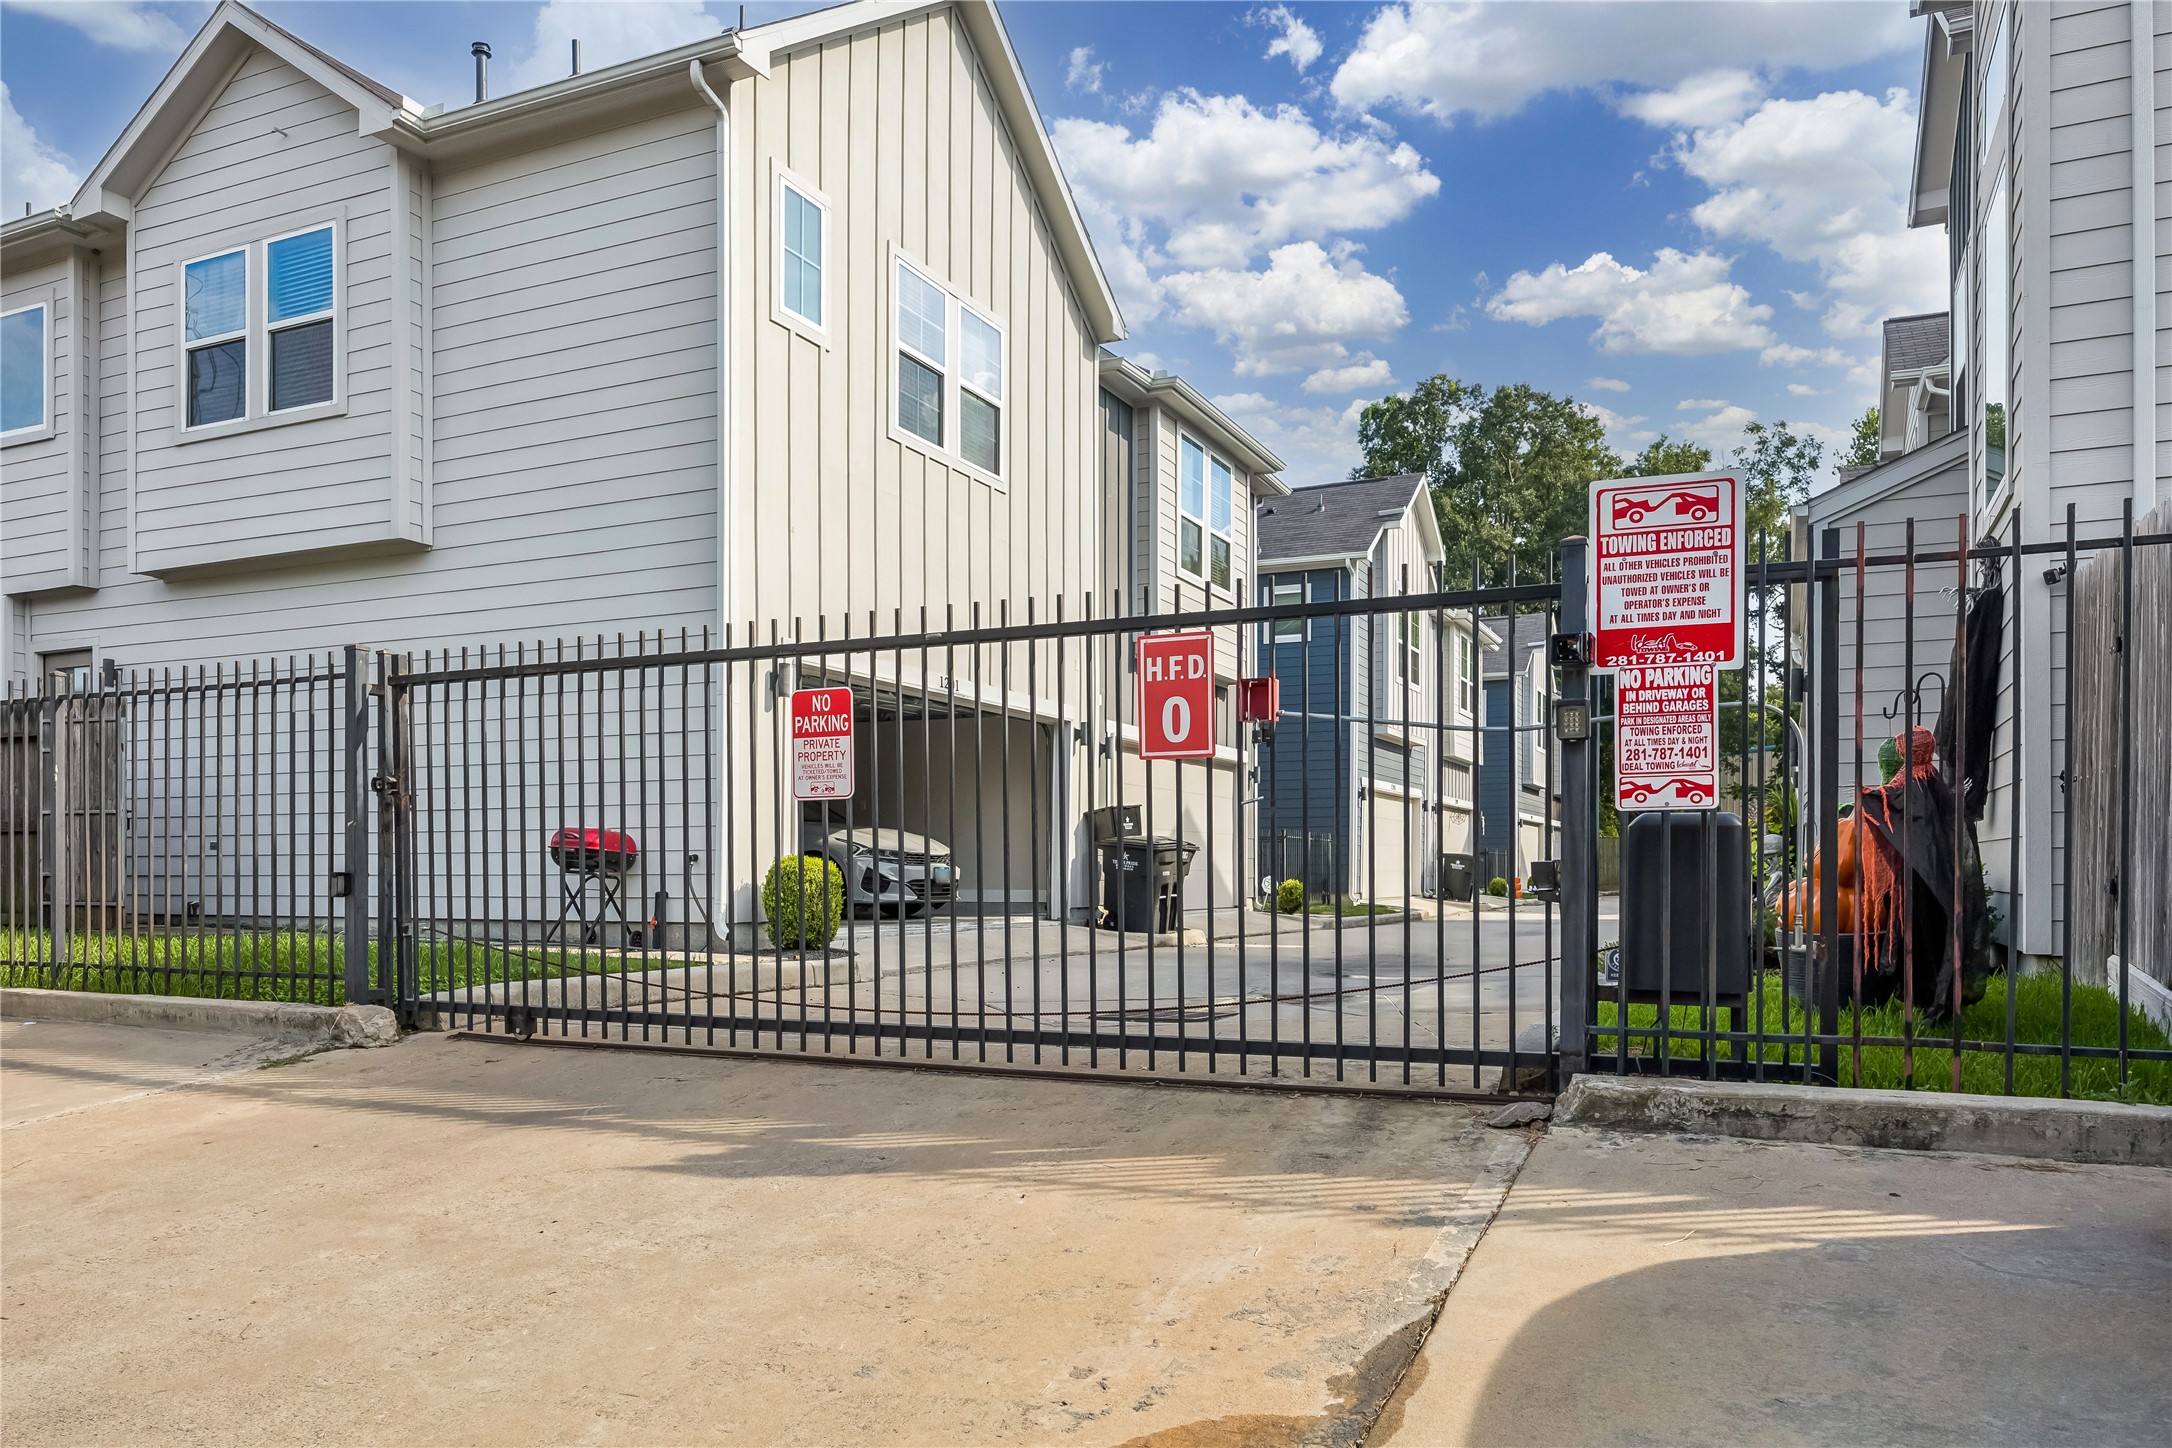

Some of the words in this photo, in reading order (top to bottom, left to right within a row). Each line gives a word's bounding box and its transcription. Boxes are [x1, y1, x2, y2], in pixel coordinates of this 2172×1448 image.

[1600, 533, 1656, 555] TOWING
[1660, 528, 1732, 550] ENFORCED
[1603, 562, 1616, 572] ALL
[1619, 560, 1643, 571] OTHER
[1645, 558, 1680, 569] VEHICLES
[1683, 554, 1728, 567] PROHIBITED
[1602, 574, 1658, 586] UNAUTHORIZED
[1660, 570, 1696, 582] VEHICLES
[1698, 568, 1717, 579] WILL
[1719, 567, 1730, 577] BE
[1621, 585, 1647, 597] TOWED
[1649, 586, 1659, 596] AT
[1661, 583, 1697, 595] OWNER'S
[1699, 582, 1710, 592] OR
[1624, 598, 1670, 610] OPERATOR'S
[1672, 596, 1706, 607] EXPENSE
[1609, 615, 1618, 624] AT
[1620, 614, 1634, 624] ALL
[1636, 612, 1660, 623] TIMES
[1662, 611, 1677, 621] DAY
[1680, 609, 1696, 620] AND
[1698, 608, 1722, 619] NIGHT
[1606, 650, 1725, 666] 281-787-1401
[1146, 654, 1207, 682] H.F.D.
[1620, 669, 1642, 689] NO
[1645, 665, 1712, 688] PARKING
[1625, 690, 1636, 702] IN
[1638, 688, 1689, 702] DRIVEWAY
[1691, 687, 1706, 699] OR
[812, 694, 831, 712] NO
[1623, 702, 1660, 714] BEHIND
[1662, 700, 1709, 712] GARAGES
[795, 714, 849, 734] PARKING
[1621, 717, 1635, 726] PARK
[1643, 715, 1677, 725] DESIGNATED
[1678, 715, 1696, 723] AREAS
[1697, 714, 1712, 722] ONLY
[1630, 726, 1660, 737] TOWING
[1662, 724, 1702, 735] ENFORCED
[804, 738, 840, 750] PRIVATE
[1625, 739, 1632, 747] AT
[1634, 738, 1645, 746] ALL
[1647, 737, 1666, 746] TIMES
[1668, 737, 1679, 745] DAY
[1682, 736, 1686, 744] &
[1688, 736, 1708, 744] NIGHT
[798, 750, 846, 762] PROPERTY
[1626, 746, 1708, 761] 281-787-1401
[1622, 762, 1644, 771] IDEAL
[1646, 761, 1676, 770] TOWING
